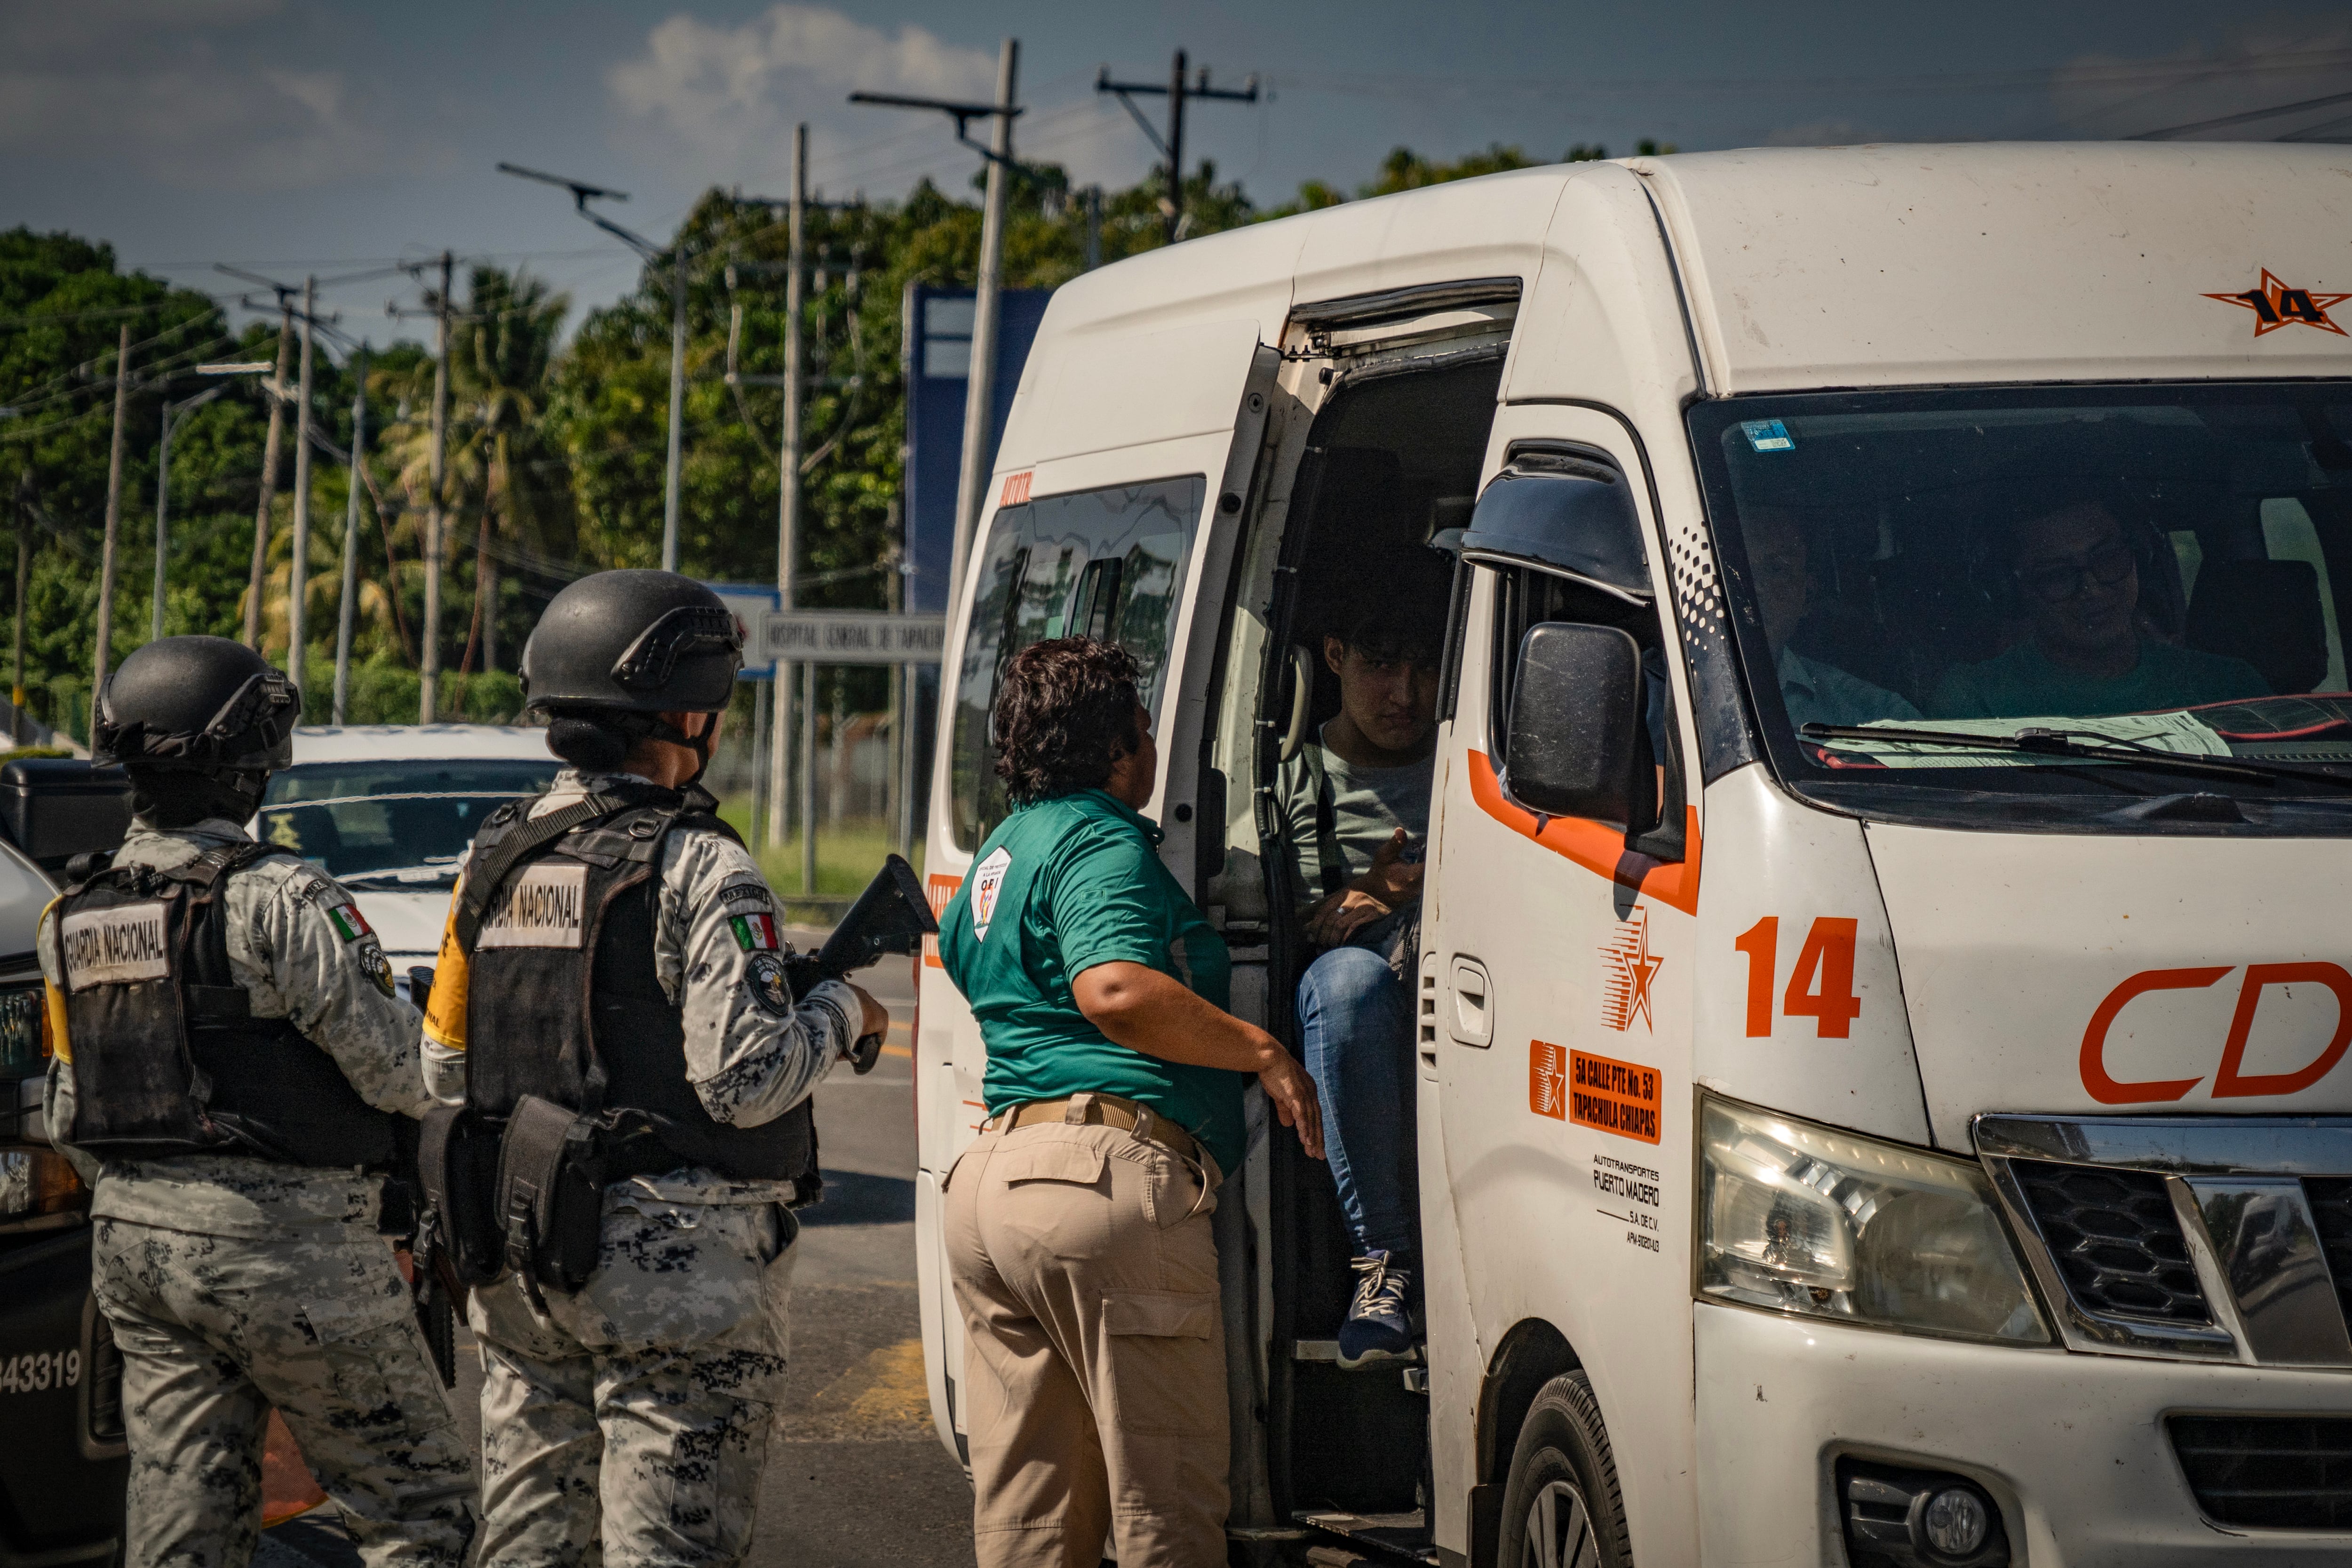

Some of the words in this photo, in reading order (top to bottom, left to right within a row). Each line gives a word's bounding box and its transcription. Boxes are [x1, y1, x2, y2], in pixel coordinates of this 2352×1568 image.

[2236, 289, 2325, 323] 14
[981, 877, 999, 891] OPI
[518, 884, 579, 928] NACIONAL
[65, 927, 101, 973] GUARDIA
[103, 919, 163, 963] NACIONAL
[1735, 916, 1860, 1039] 14
[1576, 1057, 1586, 1085] 5A
[1588, 1060, 1610, 1091] CALLE
[1612, 1065, 1626, 1095] PTE
[1628, 1069, 1640, 1098] No.
[1643, 1073, 1653, 1101] 53
[1573, 1092, 1618, 1129] TAPACHULA
[1620, 1103, 1655, 1138] CHIAPAS
[1594, 1154, 1659, 1182] AUTOTRANSPORTES
[1594, 1170, 1624, 1197] PUERTO
[1626, 1179, 1659, 1207] MADERO
[1629, 1210, 1640, 1226] S.A.
[1641, 1214, 1648, 1228] DE
[1649, 1217, 1659, 1232] C.V.
[0, 1350, 79, 1393] 43319
